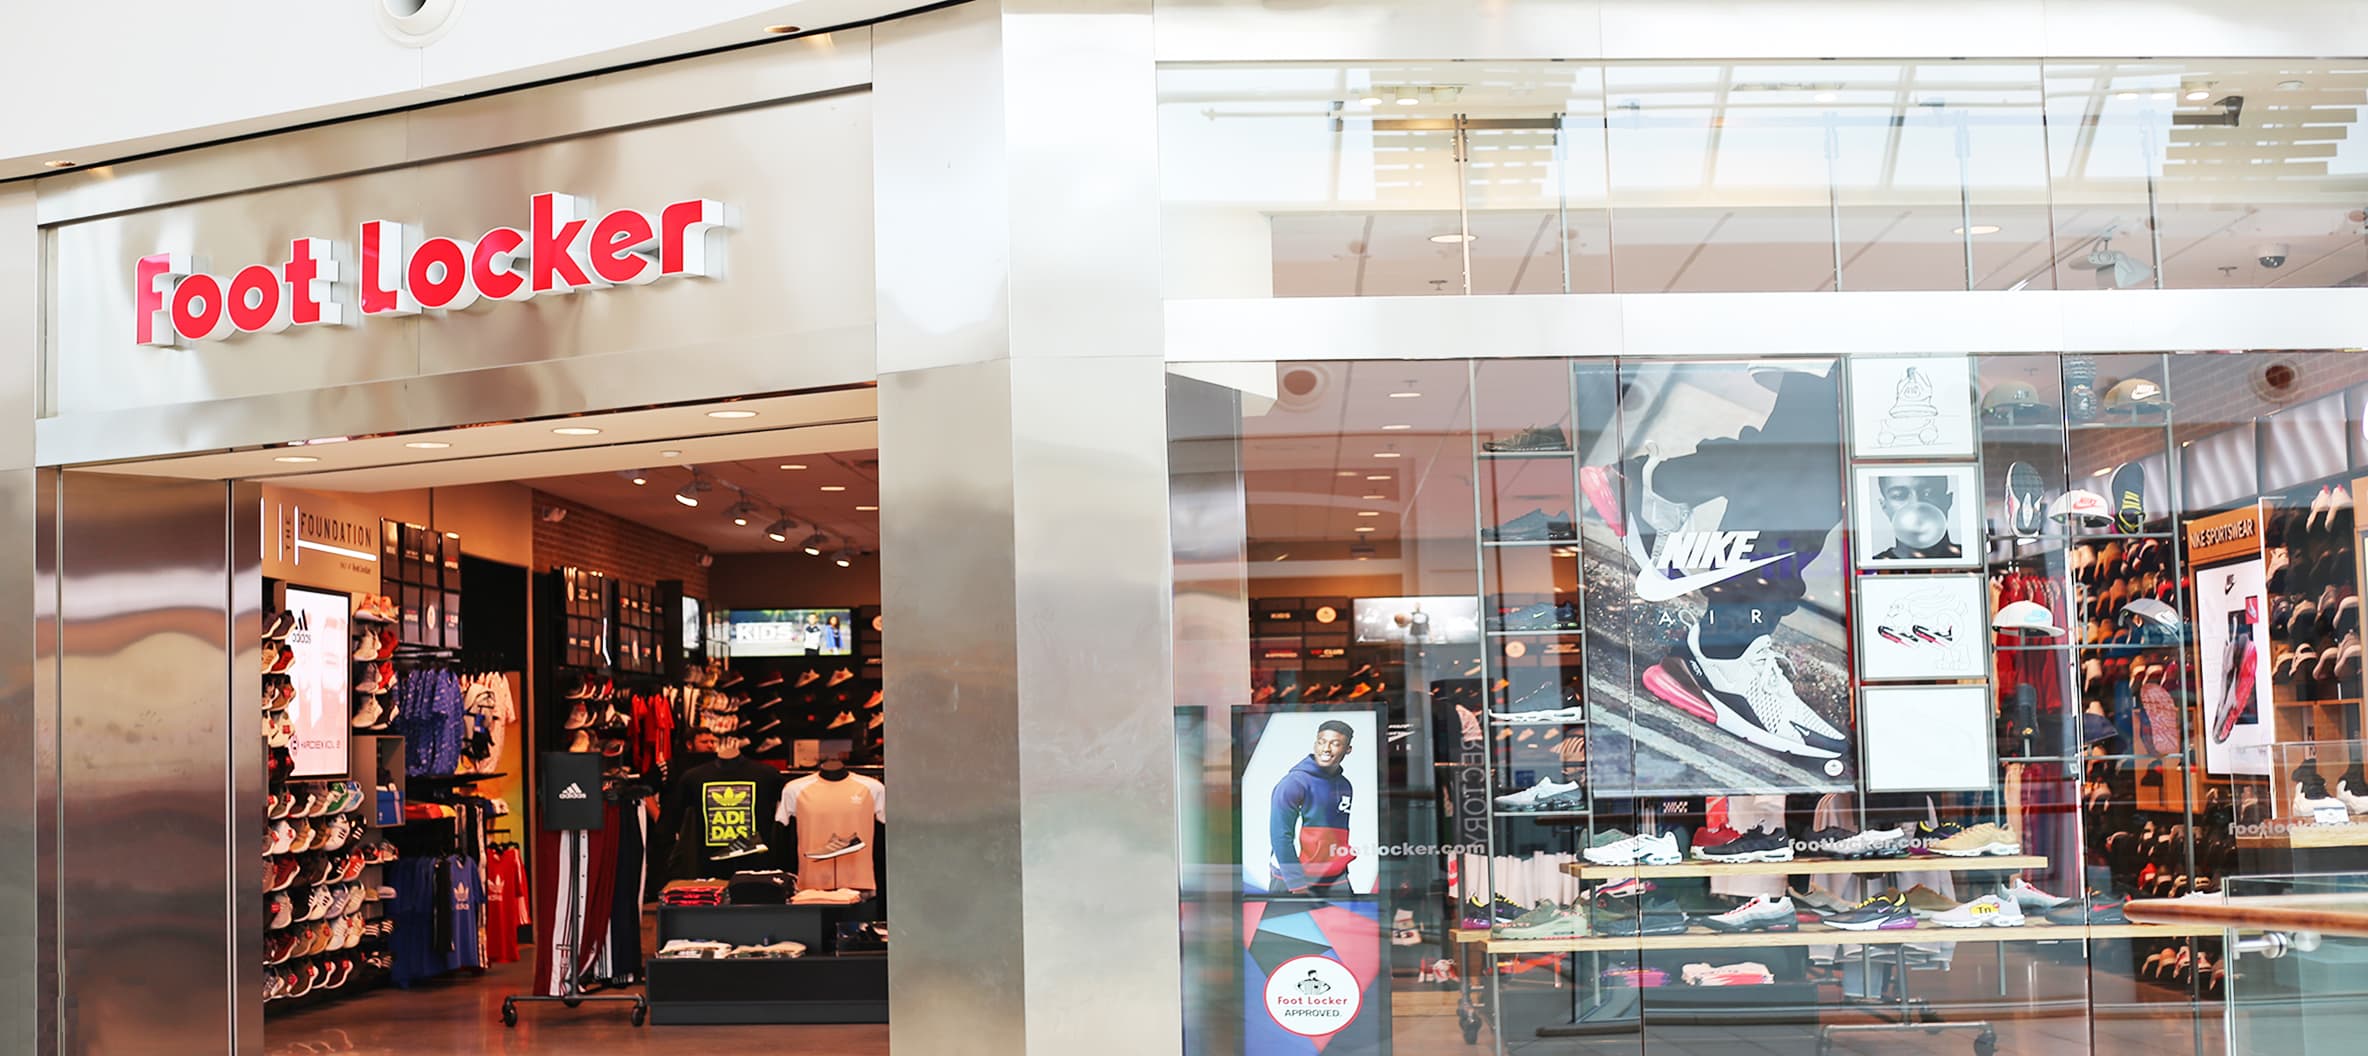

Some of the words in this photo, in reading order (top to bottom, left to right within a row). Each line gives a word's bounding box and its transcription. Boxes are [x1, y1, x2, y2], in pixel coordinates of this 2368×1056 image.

[135, 237, 336, 348] Foot
[359, 191, 722, 318] Locker
[300, 511, 372, 548] FOUNDATION
[2206, 518, 2256, 546] SPORTSWEAR
[1656, 530, 1760, 569] NIKE
[1658, 608, 1763, 627] AIR
[735, 622, 794, 641] KIDS
[711, 810, 746, 825] ADI
[711, 826, 749, 841] DAS
[1328, 842, 1486, 857] footlocker.com
[1277, 995, 1303, 1005] Foot
[1307, 995, 1348, 1005] Locker
